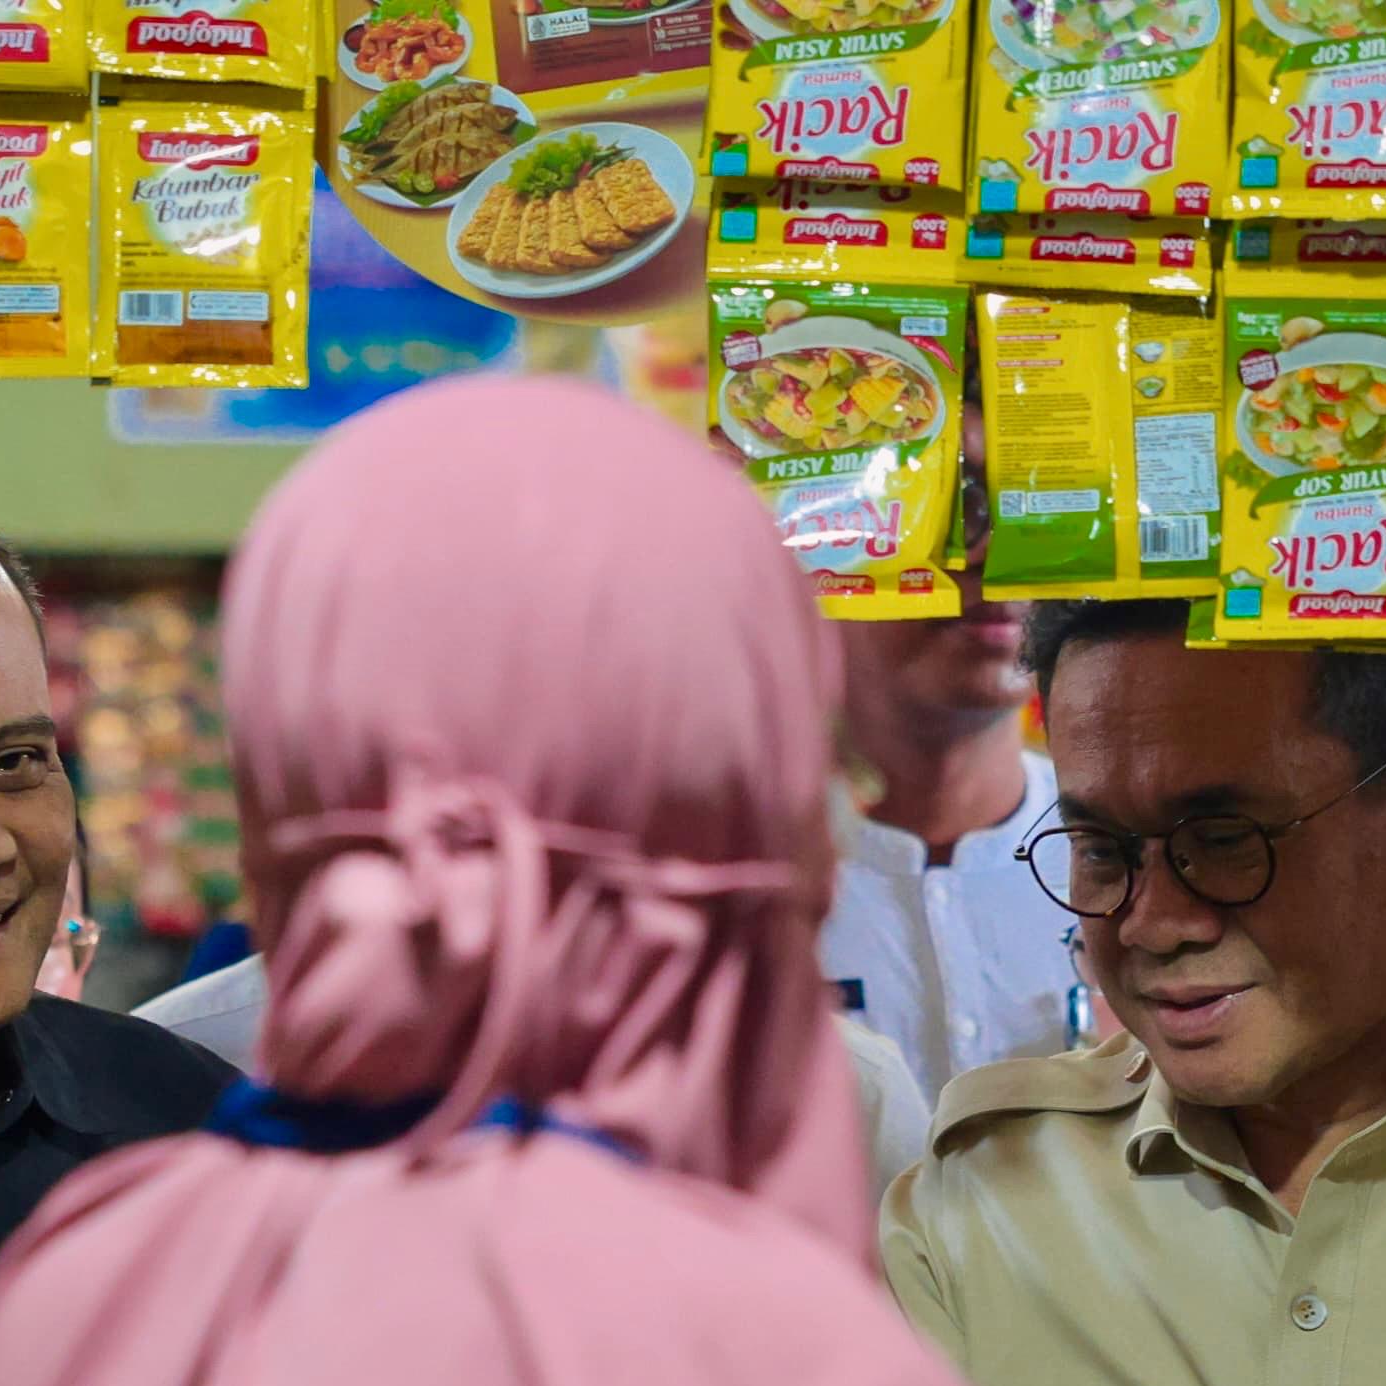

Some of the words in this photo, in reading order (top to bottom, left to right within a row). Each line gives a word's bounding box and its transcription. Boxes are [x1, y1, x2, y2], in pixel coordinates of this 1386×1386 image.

[549, 13, 587, 28] HALAL
[138, 21, 255, 48] Indofood
[838, 30, 906, 55] SAYUR
[774, 39, 832, 61] ASEM
[1311, 42, 1351, 64] SOP
[803, 70, 863, 83] Bumbu
[1109, 56, 1178, 83] SAYUR
[758, 85, 909, 153] Racik
[1025, 112, 1178, 182] Racik
[131, 173, 261, 202] Ketumbar
[1053, 186, 1141, 210] Indofood
[1175, 186, 1211, 199] 2.000
[154, 199, 240, 224] Bubuk
[791, 218, 878, 241] Indofood
[912, 217, 946, 231] 2.000
[1039, 238, 1126, 259] Indofood
[1161, 238, 1195, 250] 2.000
[768, 456, 825, 479] ASEM
[1293, 476, 1333, 496] SOP
[1314, 504, 1374, 521] Bumbu
[1297, 594, 1384, 614] Indofood
